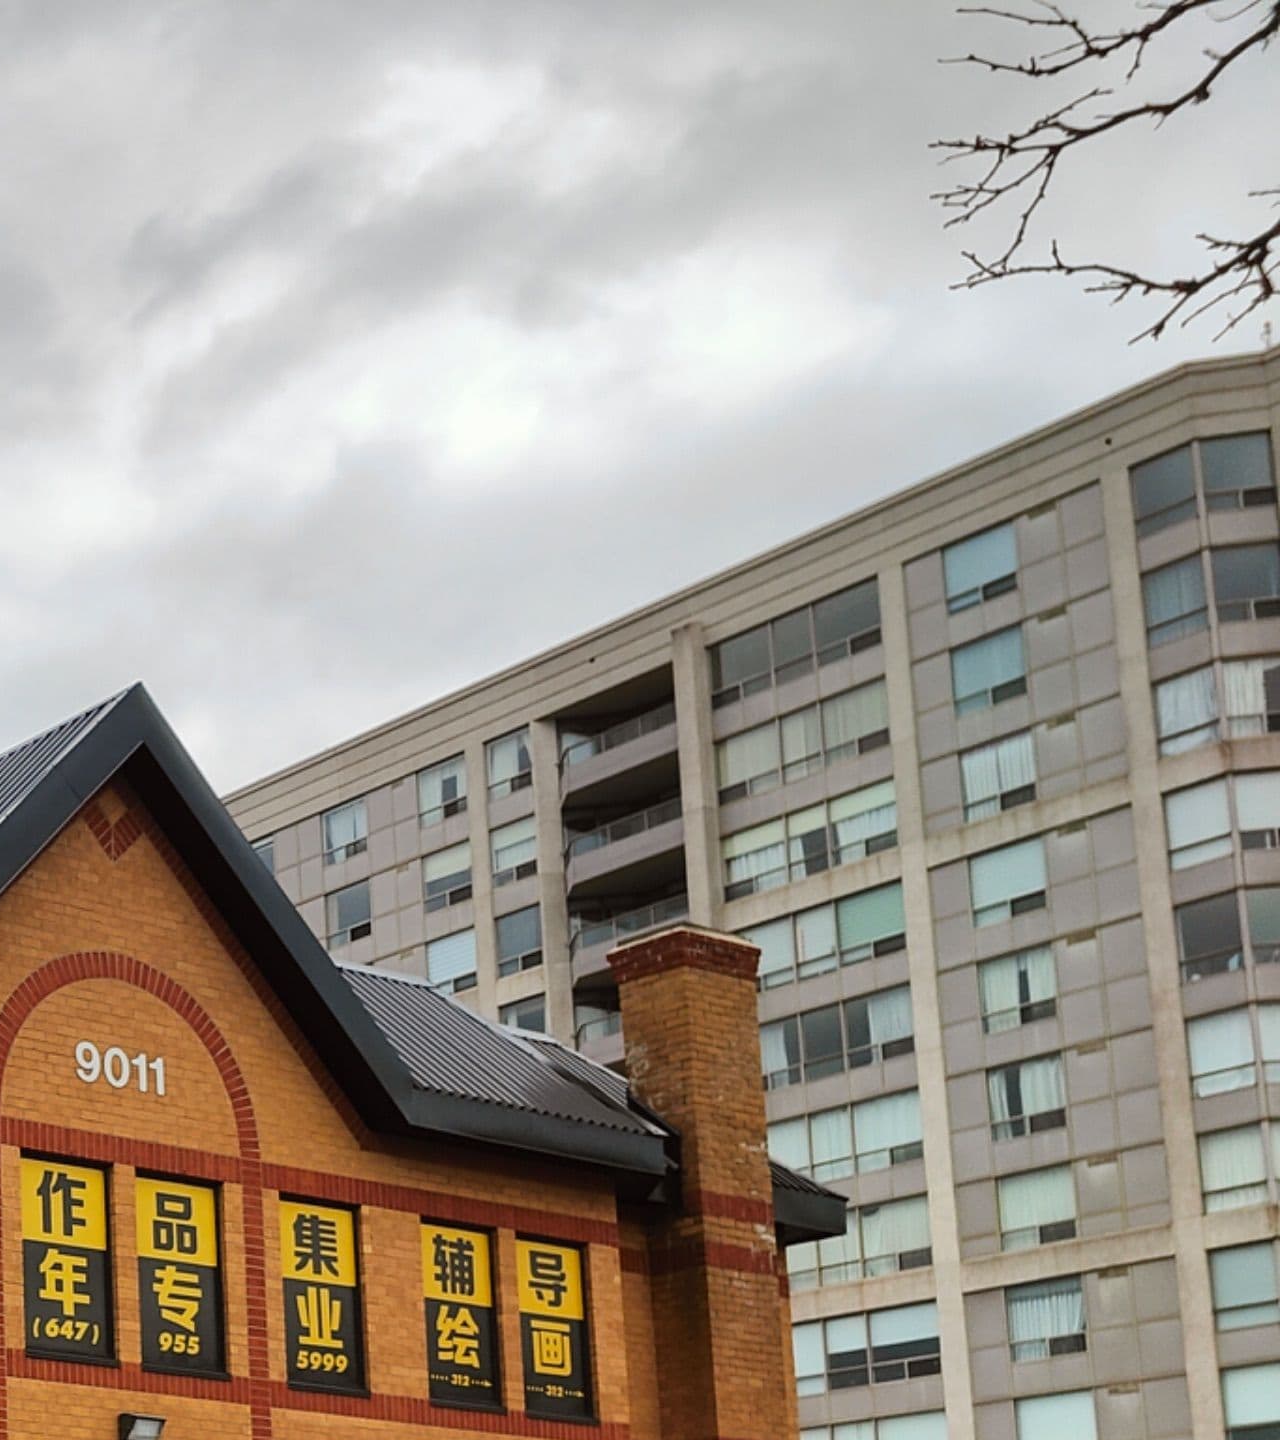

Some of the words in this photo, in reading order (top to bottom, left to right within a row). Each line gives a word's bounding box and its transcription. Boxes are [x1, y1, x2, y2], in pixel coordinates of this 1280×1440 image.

[74, 1040, 166, 1096] 9011
[36, 1169, 87, 1237] 作
[153, 1191, 197, 1254] 品
[292, 1213, 340, 1277] 集
[432, 1233, 475, 1296] 辅
[528, 1250, 567, 1307] 导
[32, 1317, 100, 1345] (647)
[159, 1332, 200, 1355] 955
[296, 1351, 348, 1373] 5999
[38, 1248, 91, 1317] 年
[153, 1264, 203, 1332] 专
[296, 1286, 344, 1349] 业
[436, 1305, 480, 1369] 绘
[530, 1319, 572, 1377] 画
